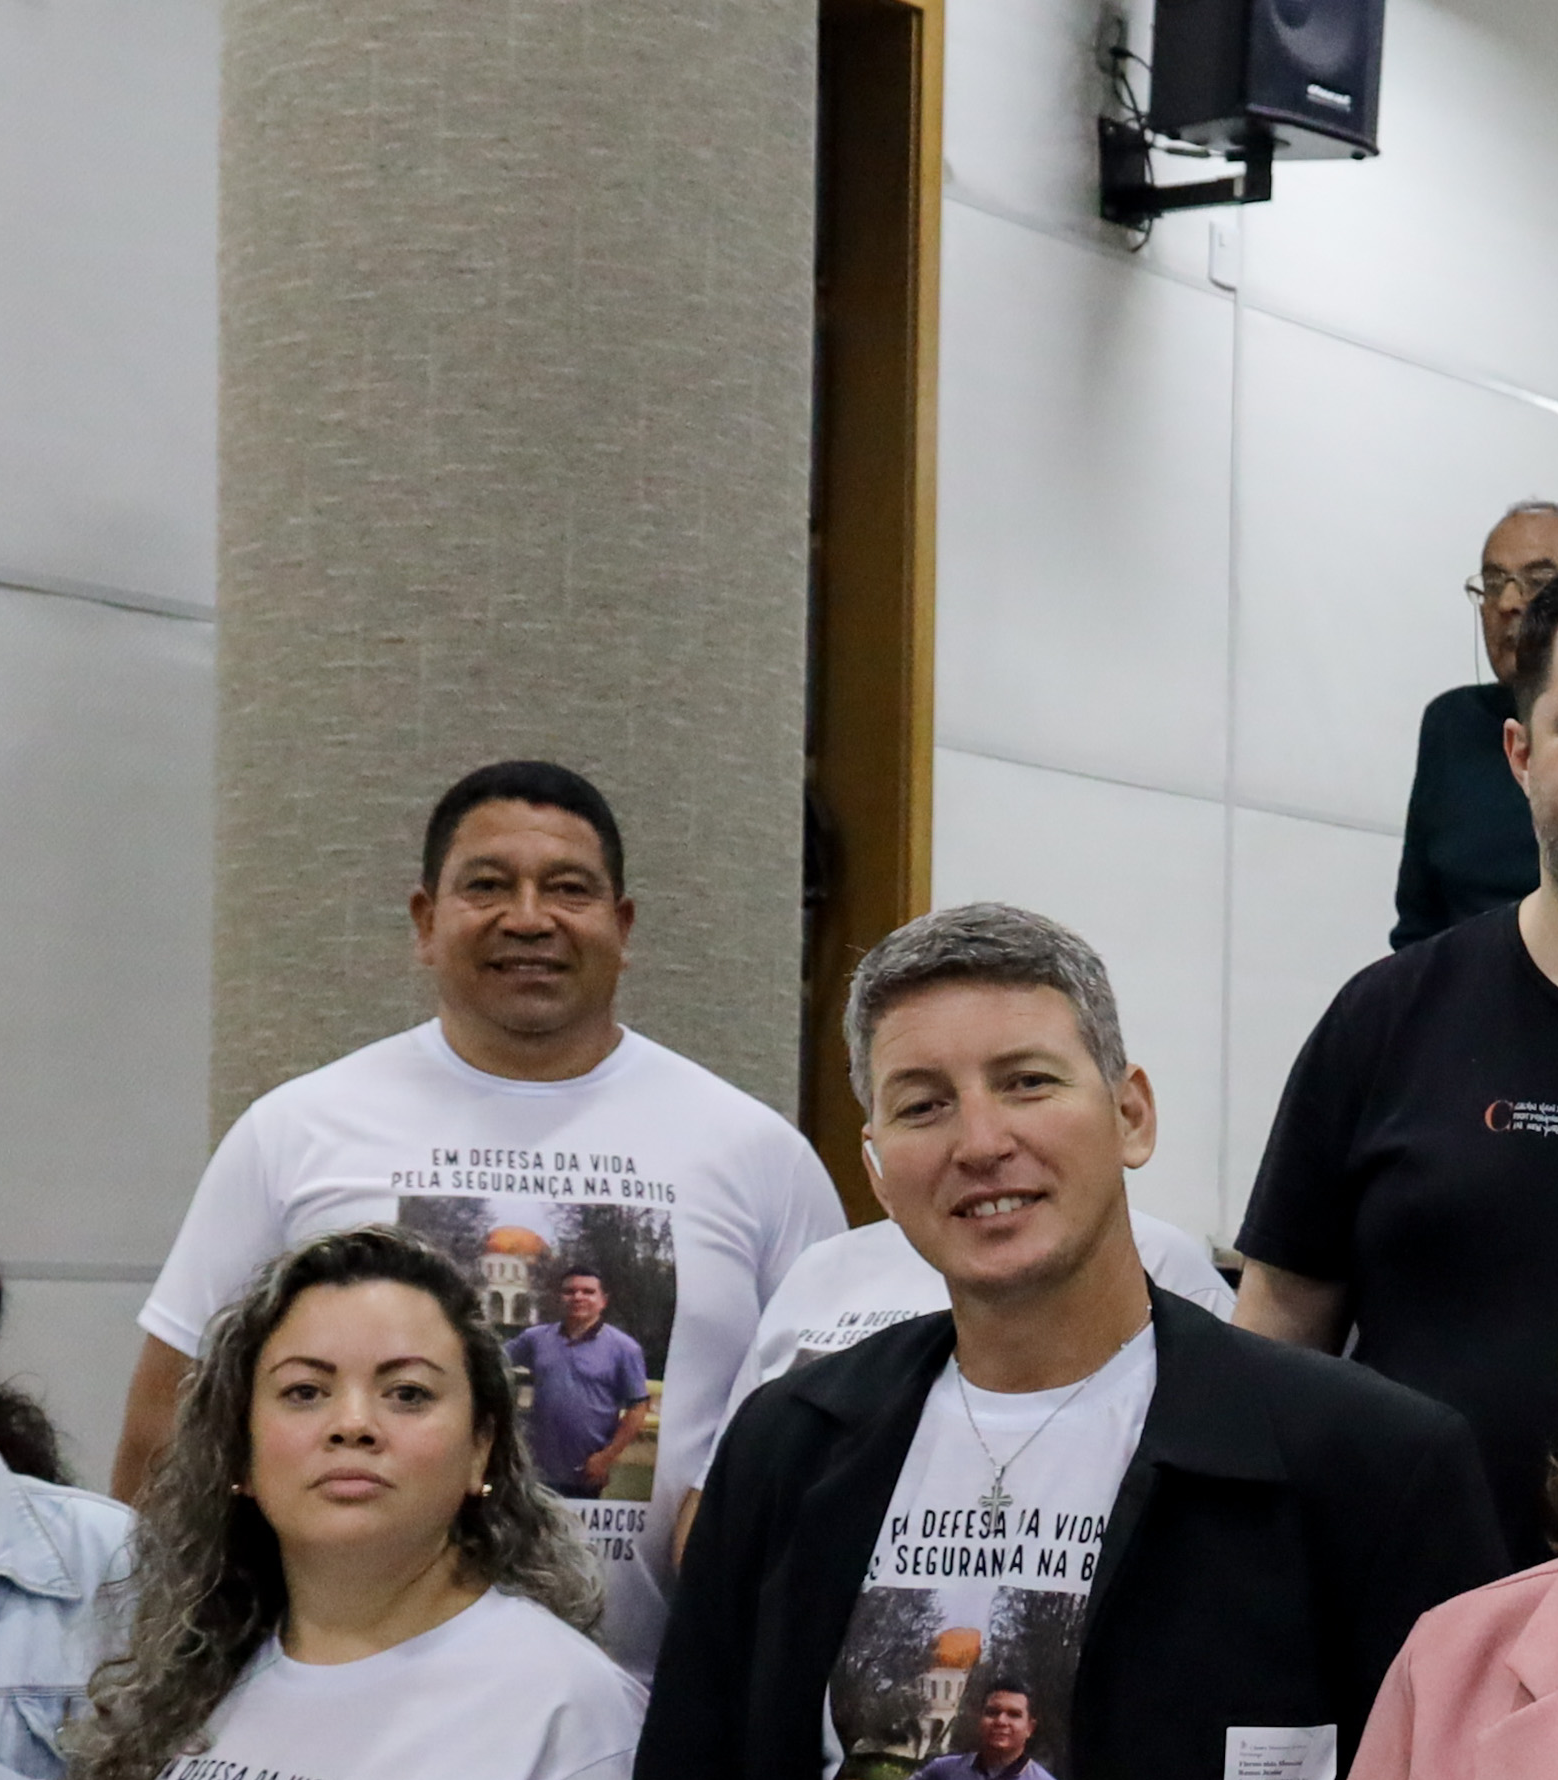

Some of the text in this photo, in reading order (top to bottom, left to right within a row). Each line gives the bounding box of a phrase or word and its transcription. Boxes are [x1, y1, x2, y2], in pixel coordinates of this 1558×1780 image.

[432, 1148, 637, 1175] EM DEFESA DA VIDA
[391, 1170, 676, 1204] PELA SEGURANÇA NA BR116
[581, 1507, 646, 1533] ARCOS
[922, 1509, 1007, 1540] DEFESA
[1055, 1512, 1108, 1544] VIDA
[1037, 1548, 1068, 1580] NA
